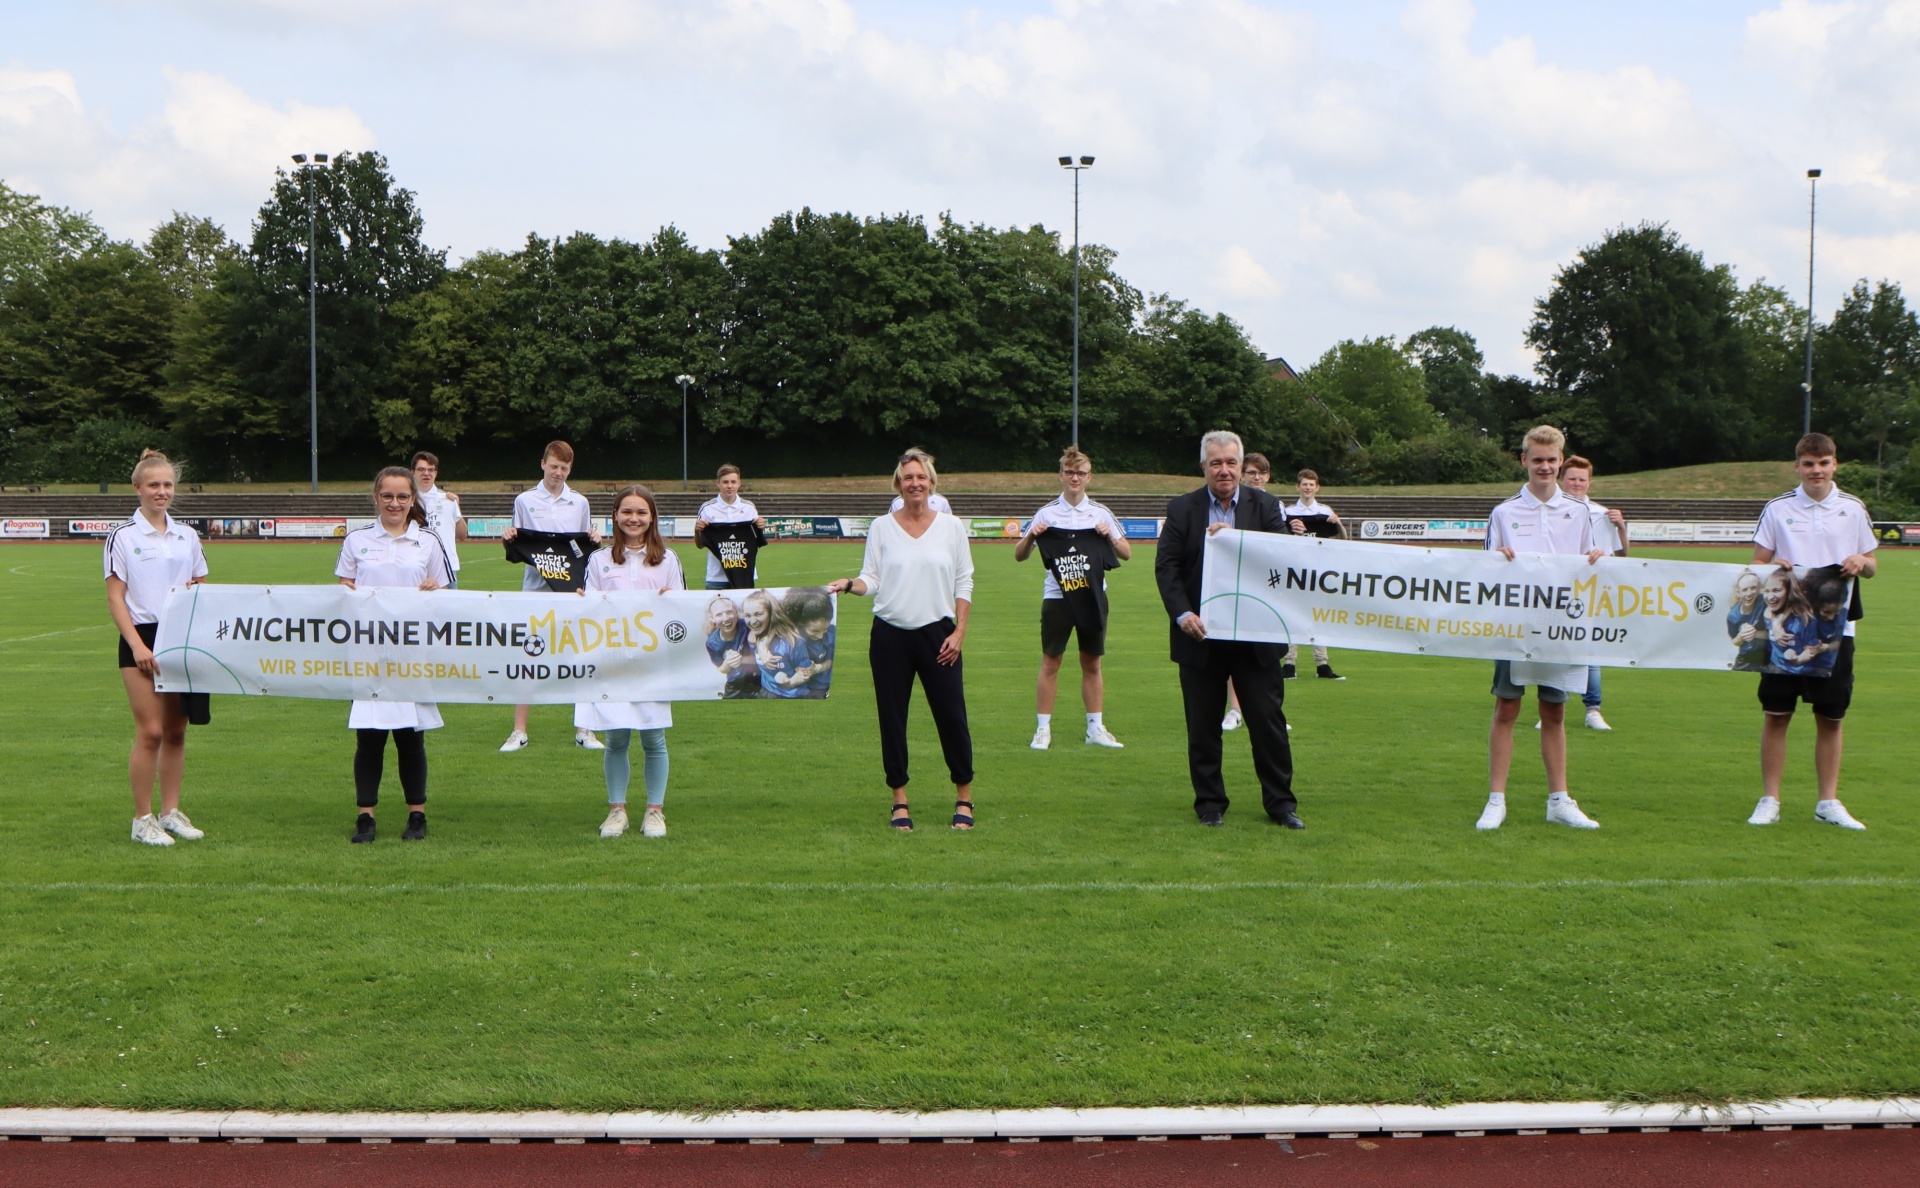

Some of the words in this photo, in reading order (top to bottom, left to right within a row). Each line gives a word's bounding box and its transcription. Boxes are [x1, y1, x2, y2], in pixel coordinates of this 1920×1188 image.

[1383, 521, 1426, 530] SÜRGERS
[1311, 607, 1349, 624] WIR
[1354, 611, 1431, 633] SPIELEN
[1436, 619, 1525, 639] FUSSBALL
[1547, 626, 1586, 641] UND
[1591, 627, 1628, 643] DU?
[259, 658, 296, 675] WIR
[302, 659, 379, 678] SPIELEN
[386, 662, 482, 679] FUSSBALL
[506, 664, 550, 680] UND
[557, 664, 596, 680] DU?
